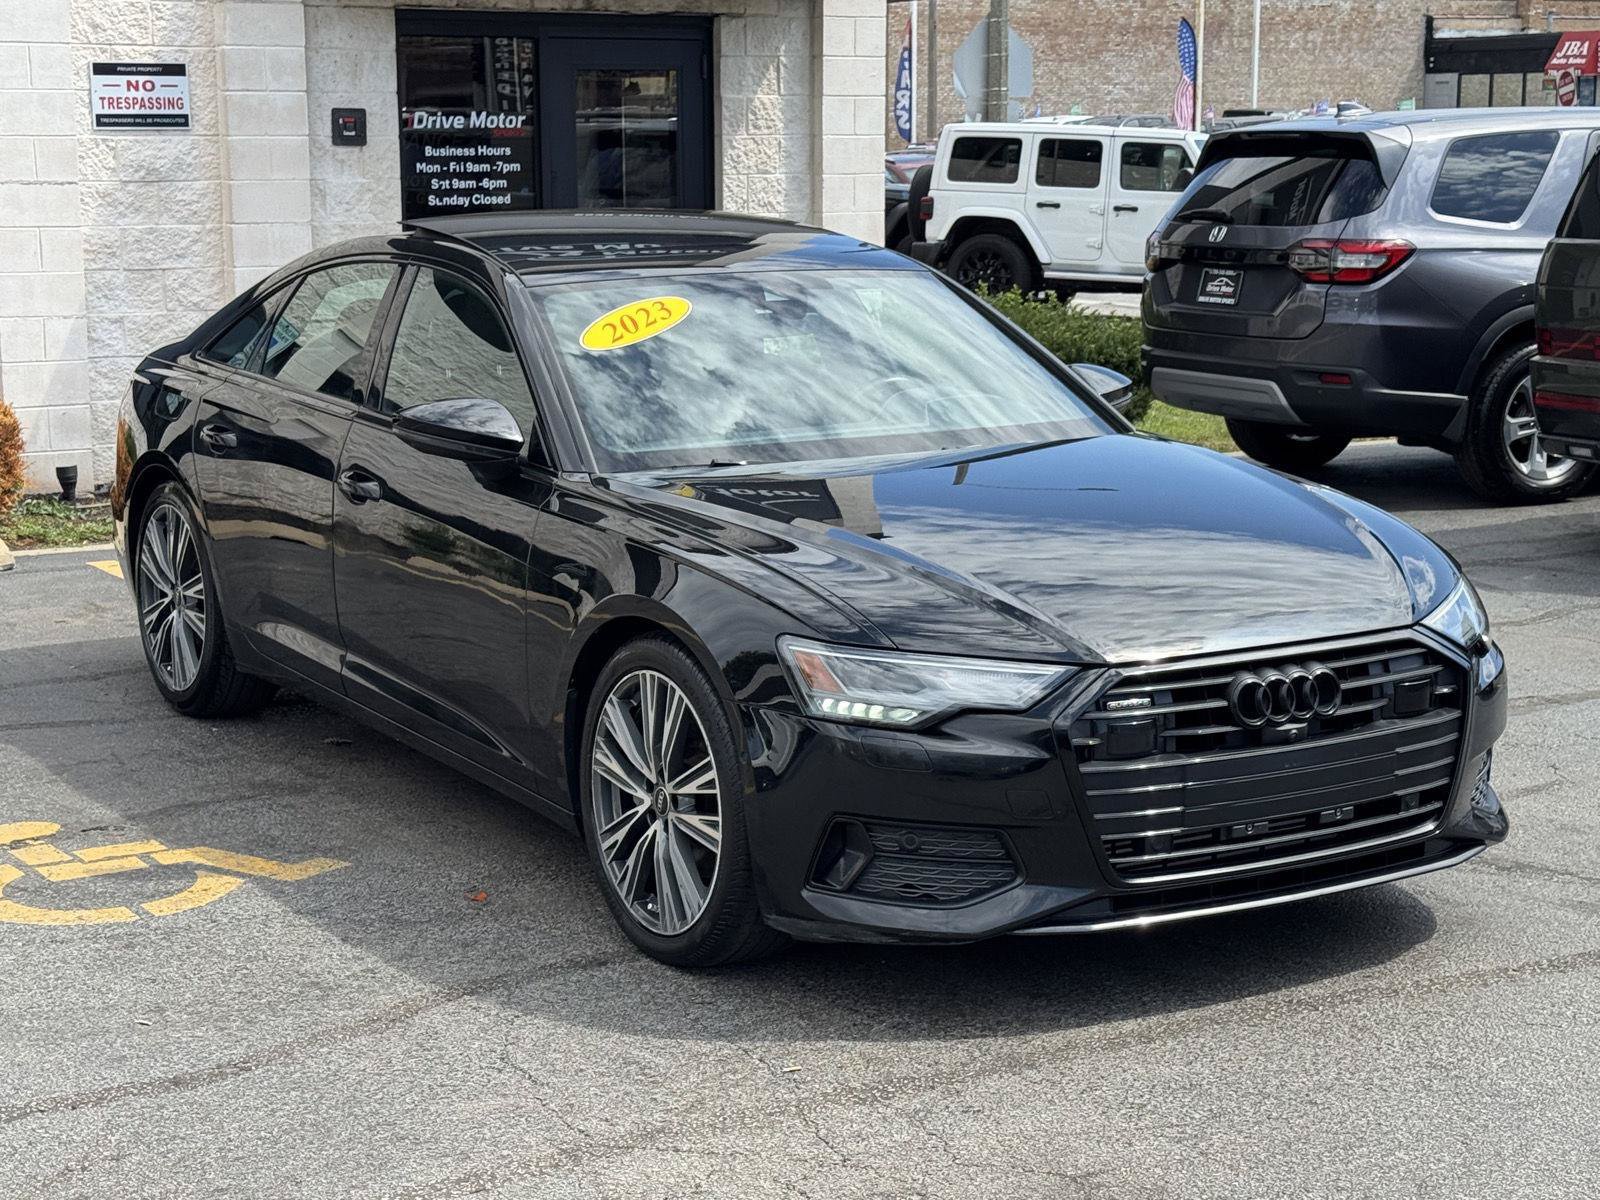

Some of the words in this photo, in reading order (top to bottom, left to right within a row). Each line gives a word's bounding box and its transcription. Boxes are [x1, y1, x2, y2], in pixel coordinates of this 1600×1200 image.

[1556, 41, 1589, 57] JBA
[1567, 57, 1586, 65] Sales
[126, 80, 156, 92] NO
[99, 96, 184, 110] TRESPASSING
[470, 111, 527, 129] Motor
[425, 146, 476, 157] Business
[477, 145, 511, 156] Hours
[416, 162, 441, 173] Mon
[466, 162, 491, 173] 9am
[431, 178, 450, 190] Sat
[452, 178, 477, 189] 9am
[428, 195, 470, 207] Sunday
[472, 193, 511, 204] Closed
[601, 301, 672, 344] 2023
